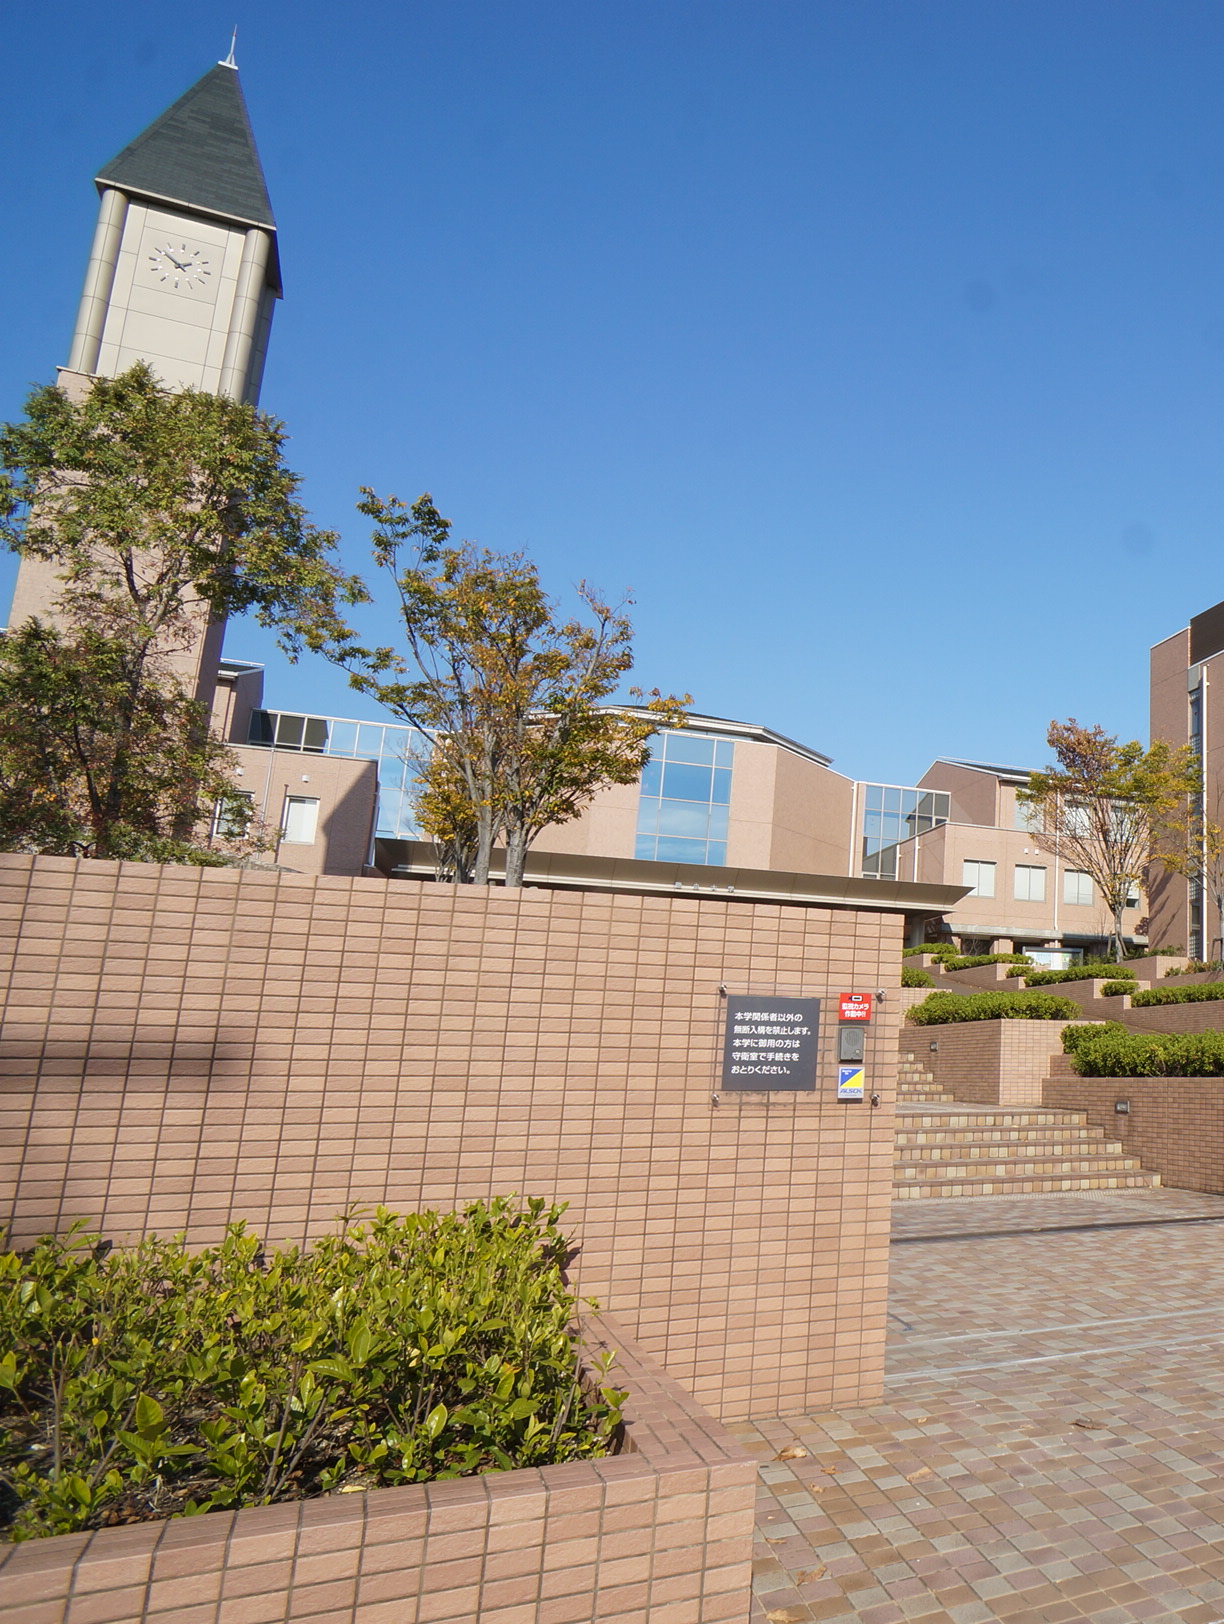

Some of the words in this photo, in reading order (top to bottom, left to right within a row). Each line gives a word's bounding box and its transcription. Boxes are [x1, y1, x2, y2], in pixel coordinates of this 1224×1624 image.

[734, 1012, 803, 1022] 本学関係者以外の
[733, 1025, 811, 1035] 無断入構を禁止します。
[732, 1039, 801, 1048] 本学に御用の方は
[731, 1052, 800, 1061] 守衛室で手続きを
[731, 1065, 791, 1075] おとりください。
